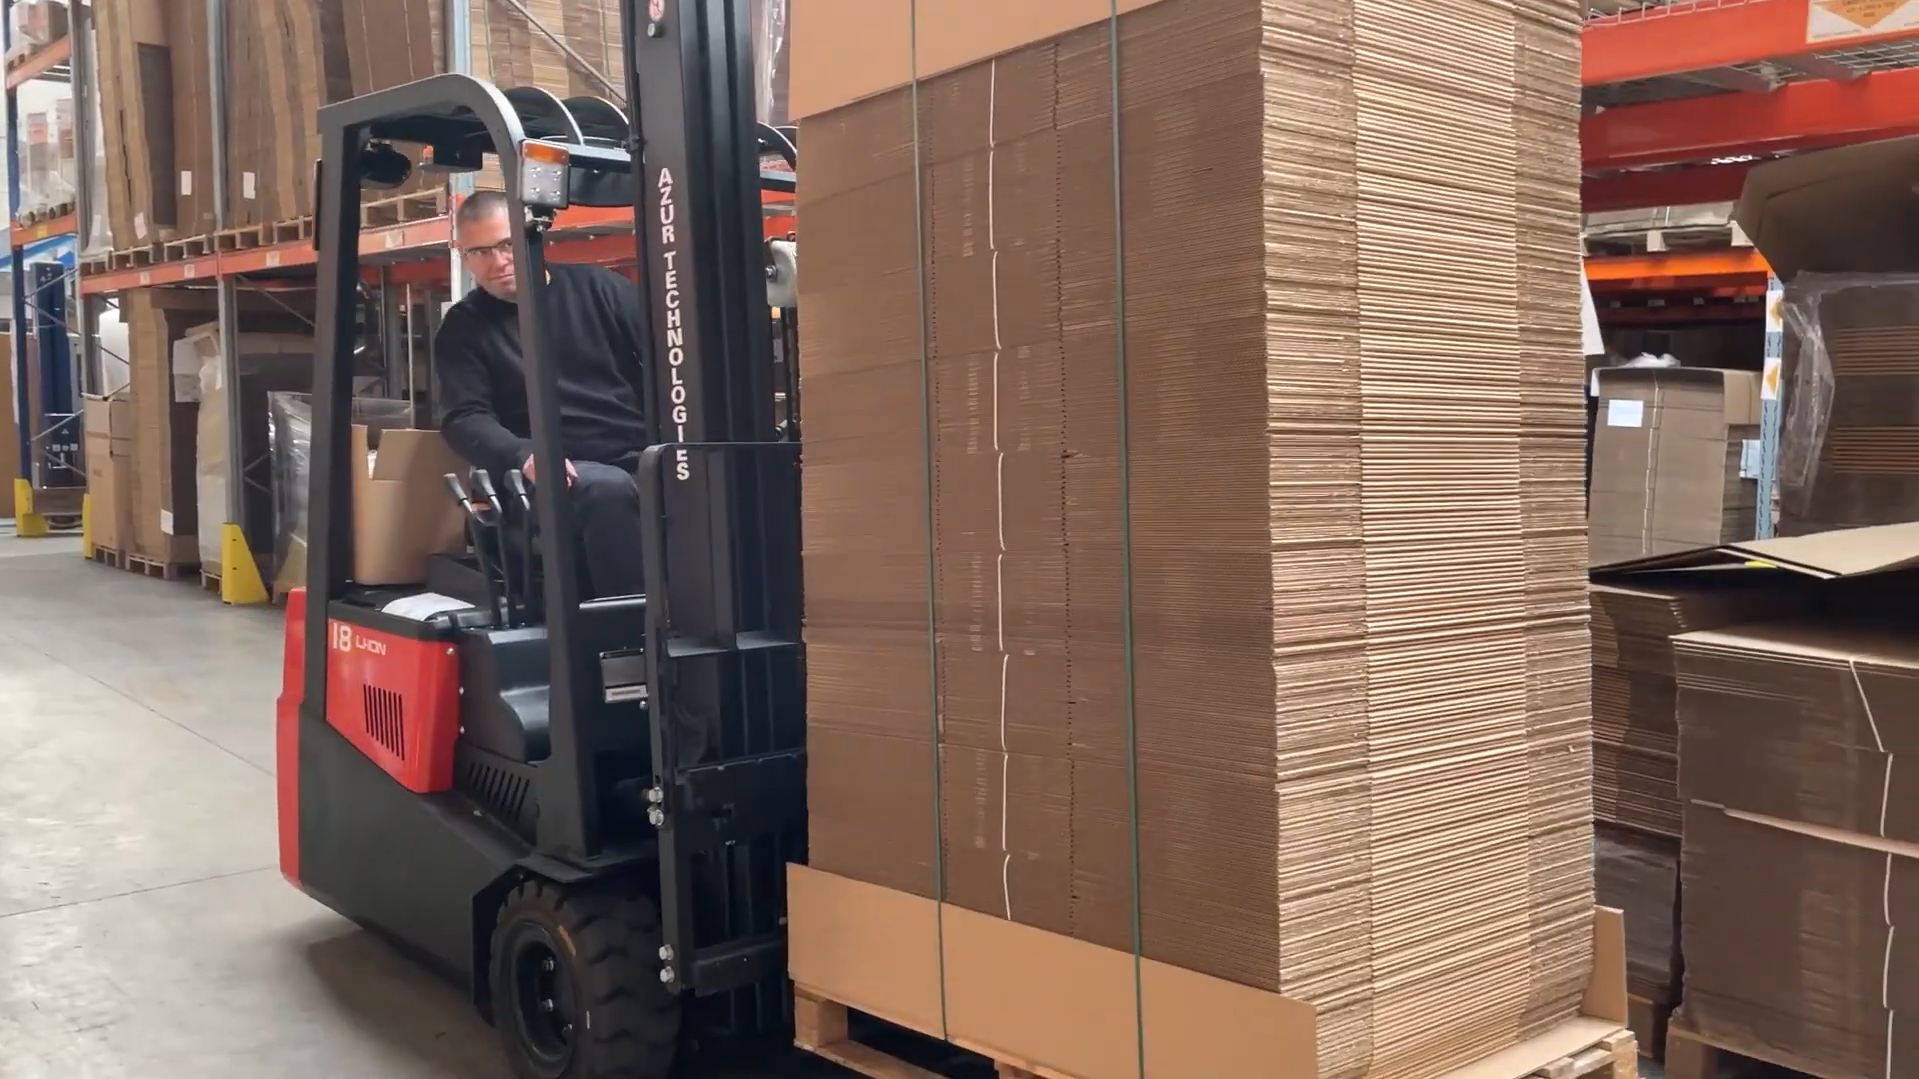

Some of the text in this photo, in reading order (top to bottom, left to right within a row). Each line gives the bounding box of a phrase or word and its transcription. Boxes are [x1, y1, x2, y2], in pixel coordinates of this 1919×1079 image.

[658, 167, 690, 480] AZUR TECHNOLOGIES
[332, 622, 352, 652] 18
